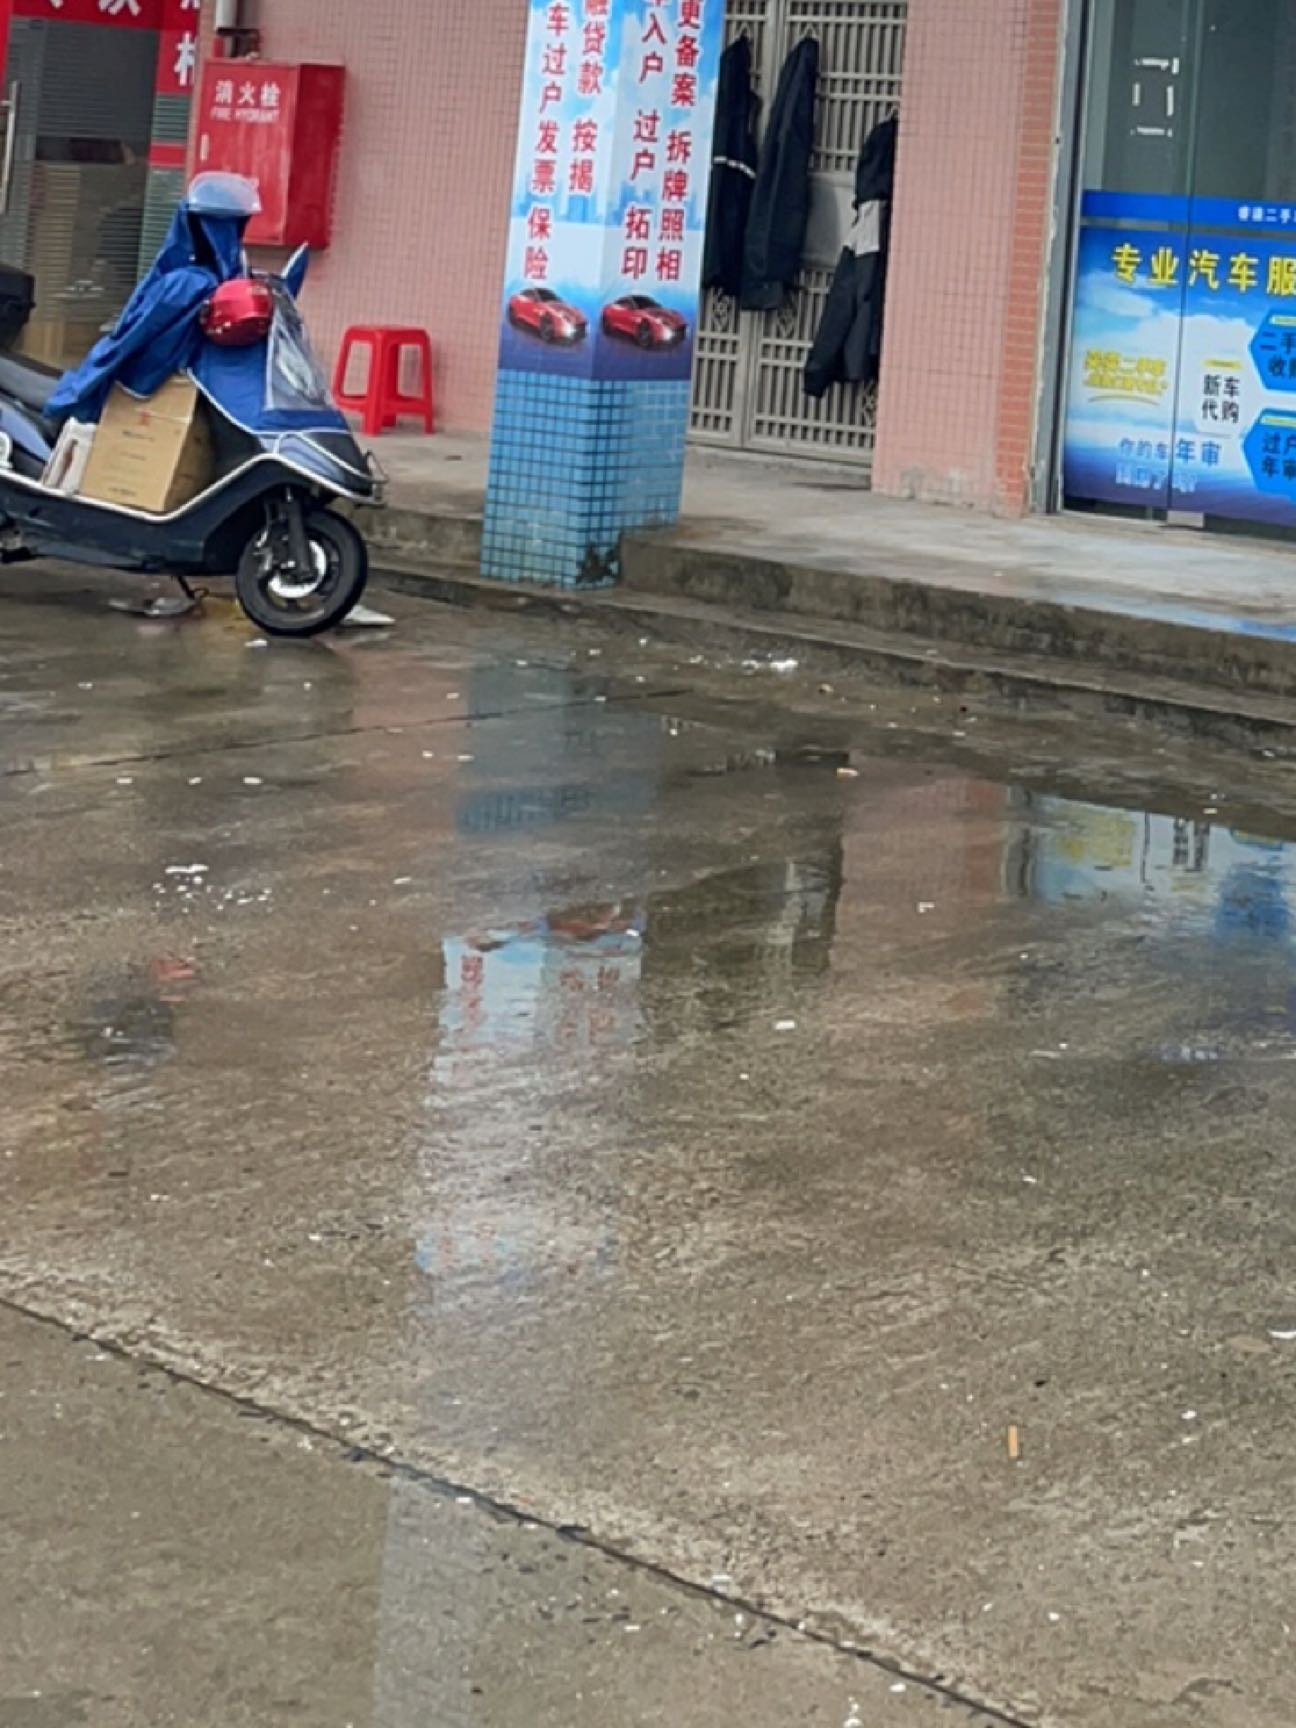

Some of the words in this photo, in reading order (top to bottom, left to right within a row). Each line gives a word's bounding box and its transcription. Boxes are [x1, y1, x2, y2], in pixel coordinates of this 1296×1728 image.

[568, 119, 598, 193] 按揭
[629, 109, 661, 181] 过户
[656, 129, 693, 281] 拆牌照相
[620, 206, 653, 280] 拓印
[1202, 373, 1240, 397] 新车
[1202, 398, 1240, 423] 代购
